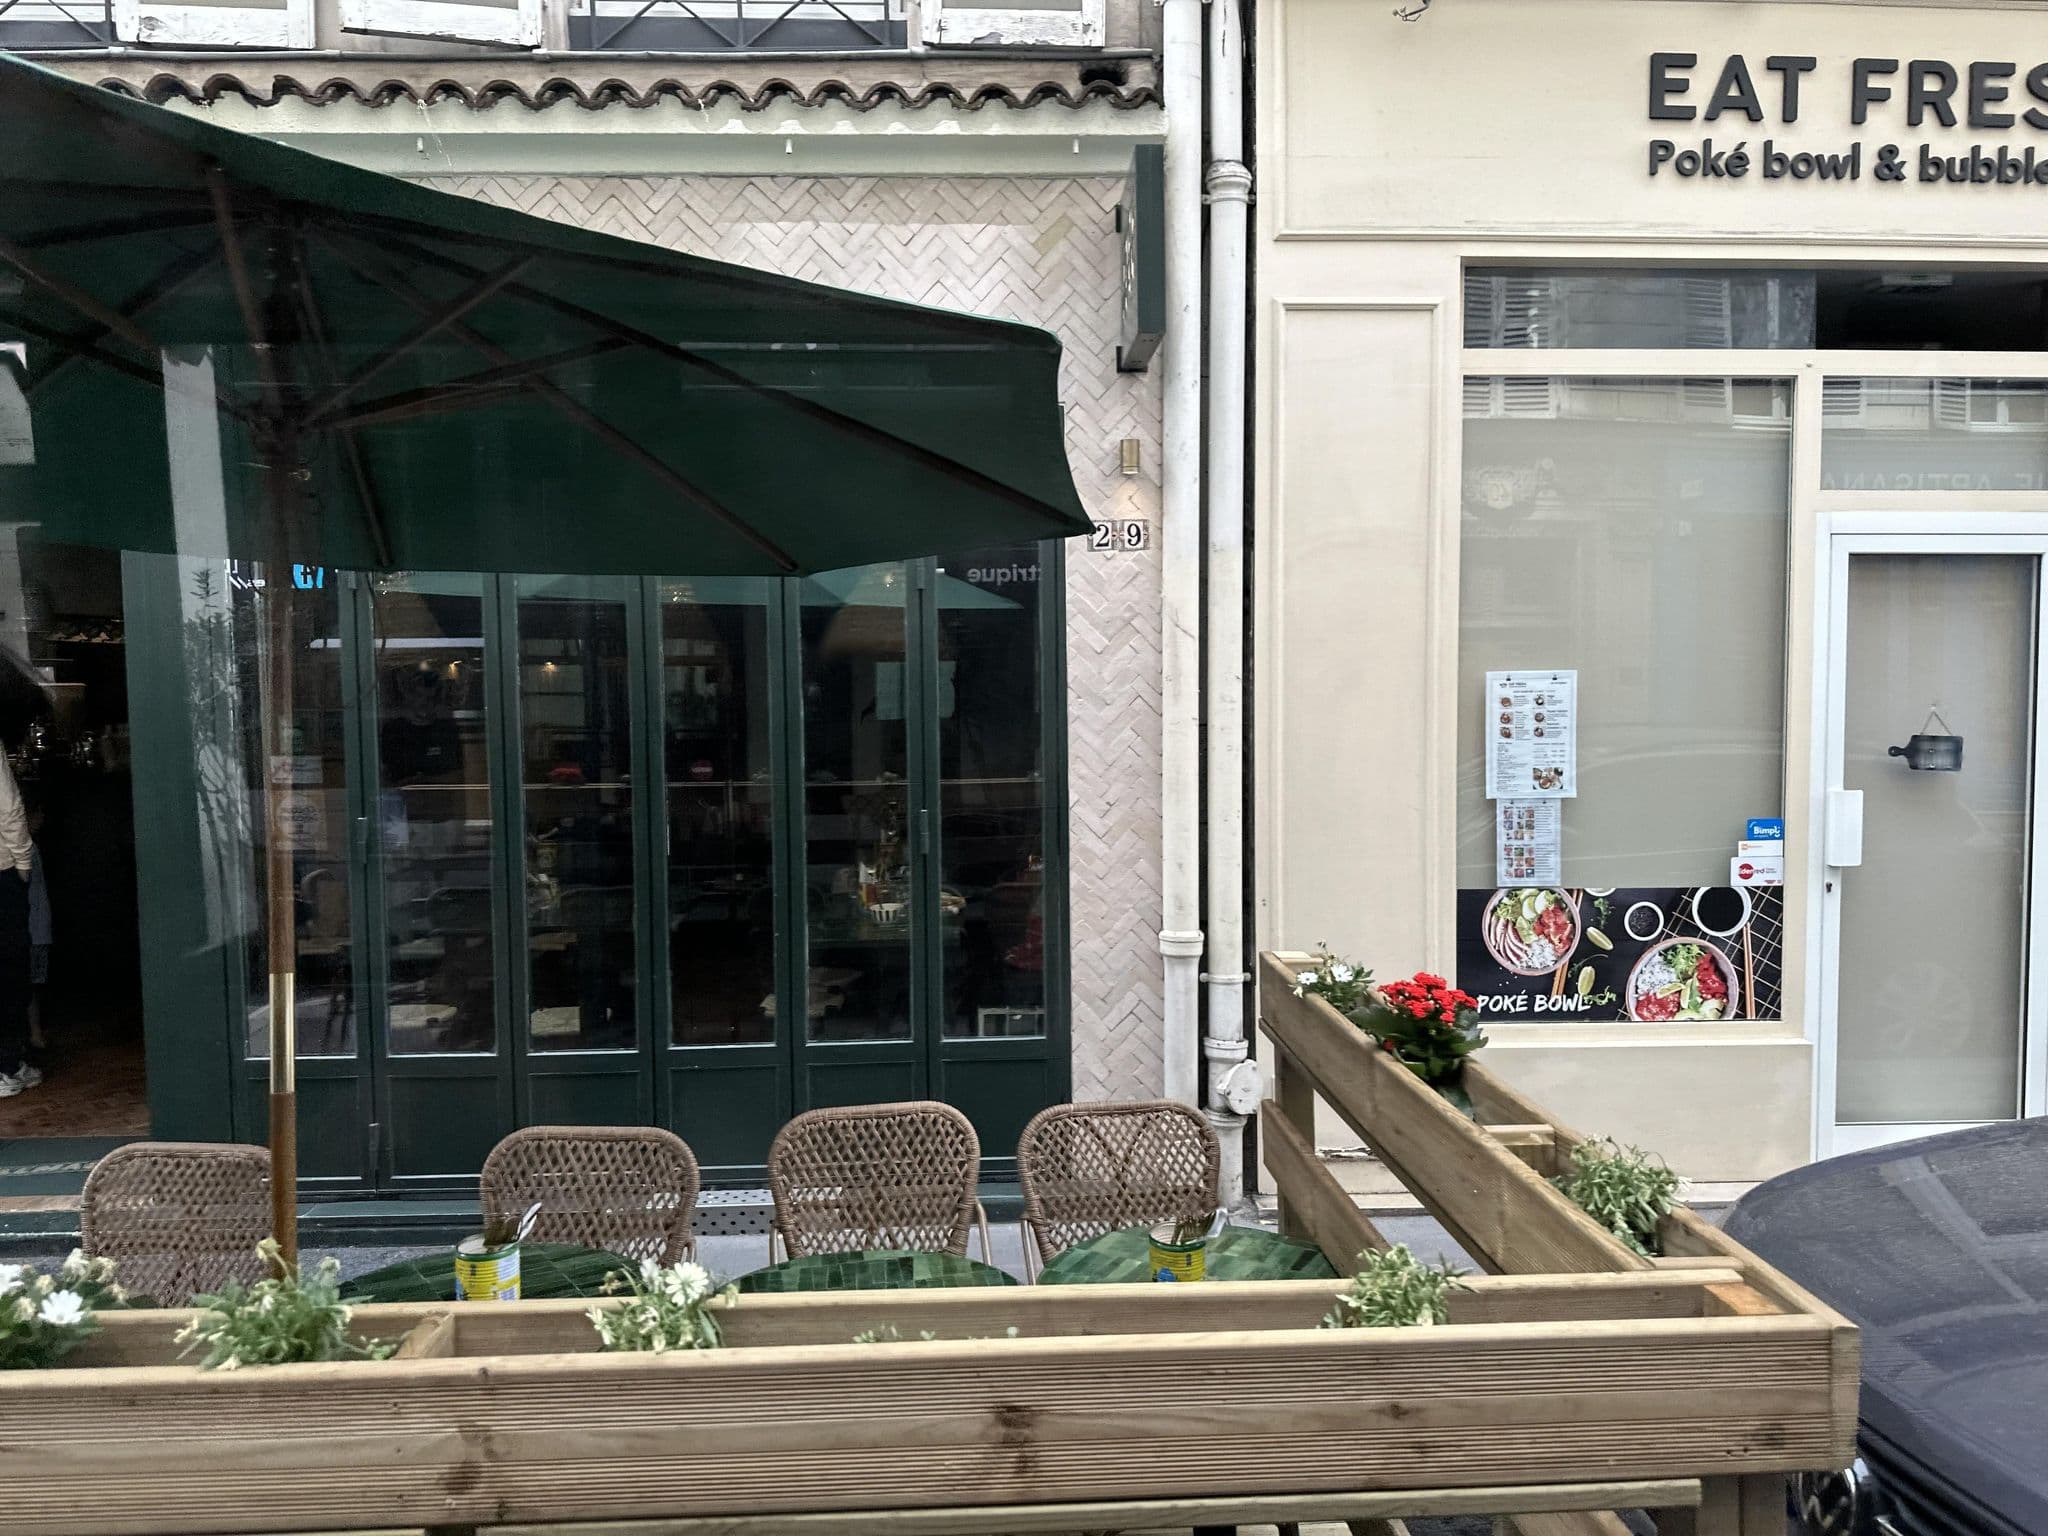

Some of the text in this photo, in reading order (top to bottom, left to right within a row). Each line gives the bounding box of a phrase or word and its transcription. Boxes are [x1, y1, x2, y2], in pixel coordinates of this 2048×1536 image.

[1649, 52, 1817, 123] EAT
[1649, 138, 1750, 179] Poké
[1763, 140, 1861, 181] bowl
[1873, 143, 1907, 182] &
[1477, 989, 1591, 1014] POKÉ BOWL
